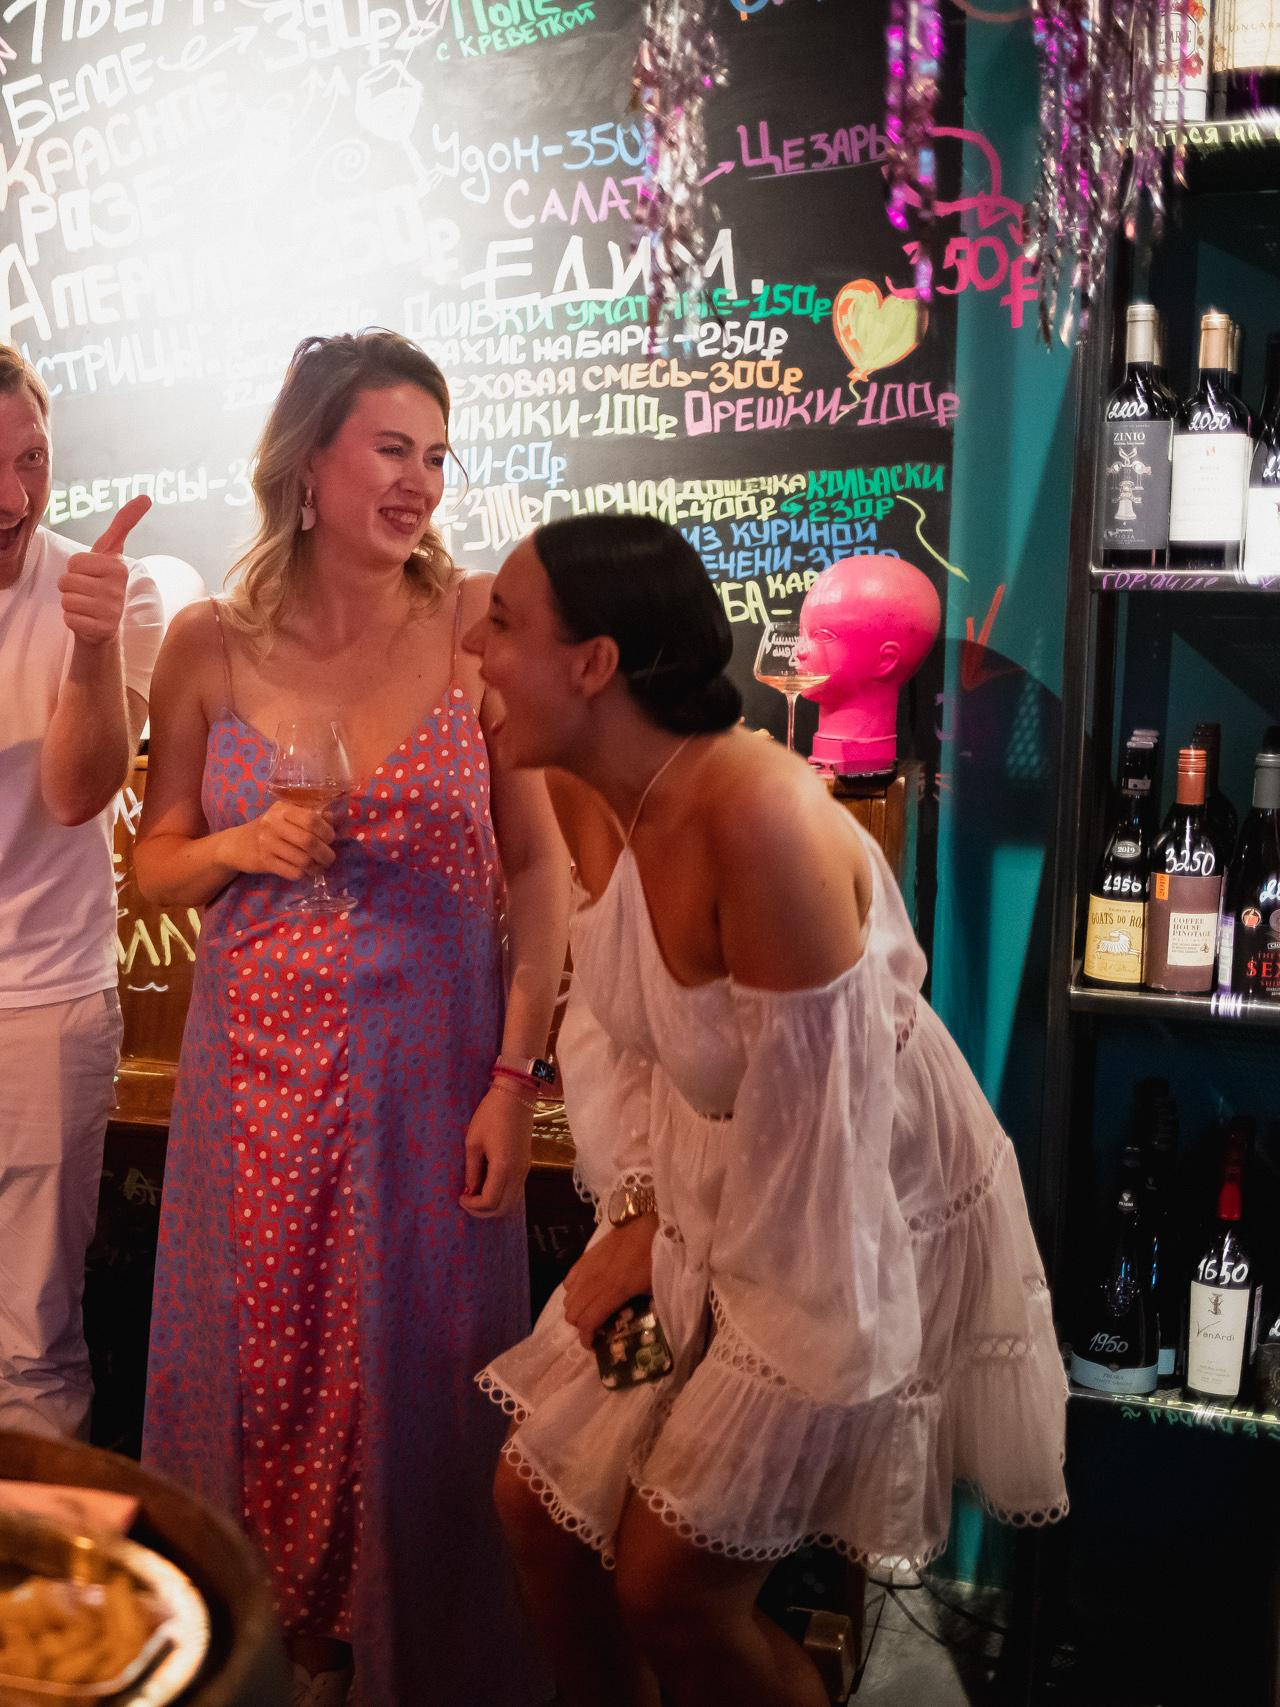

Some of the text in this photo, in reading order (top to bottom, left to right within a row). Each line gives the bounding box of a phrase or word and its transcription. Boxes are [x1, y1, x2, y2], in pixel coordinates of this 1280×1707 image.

[22, 322, 203, 396] СТРИЦЫ
[450, 366, 576, 406] ЕХОВАЯ
[1114, 432, 1145, 442] ZINIO
[730, 519, 877, 548] КУРИНОЙ
[1166, 848, 1216, 876] 3250
[1103, 874, 1142, 893] 1950
[1198, 1259, 1249, 1285] 1650
